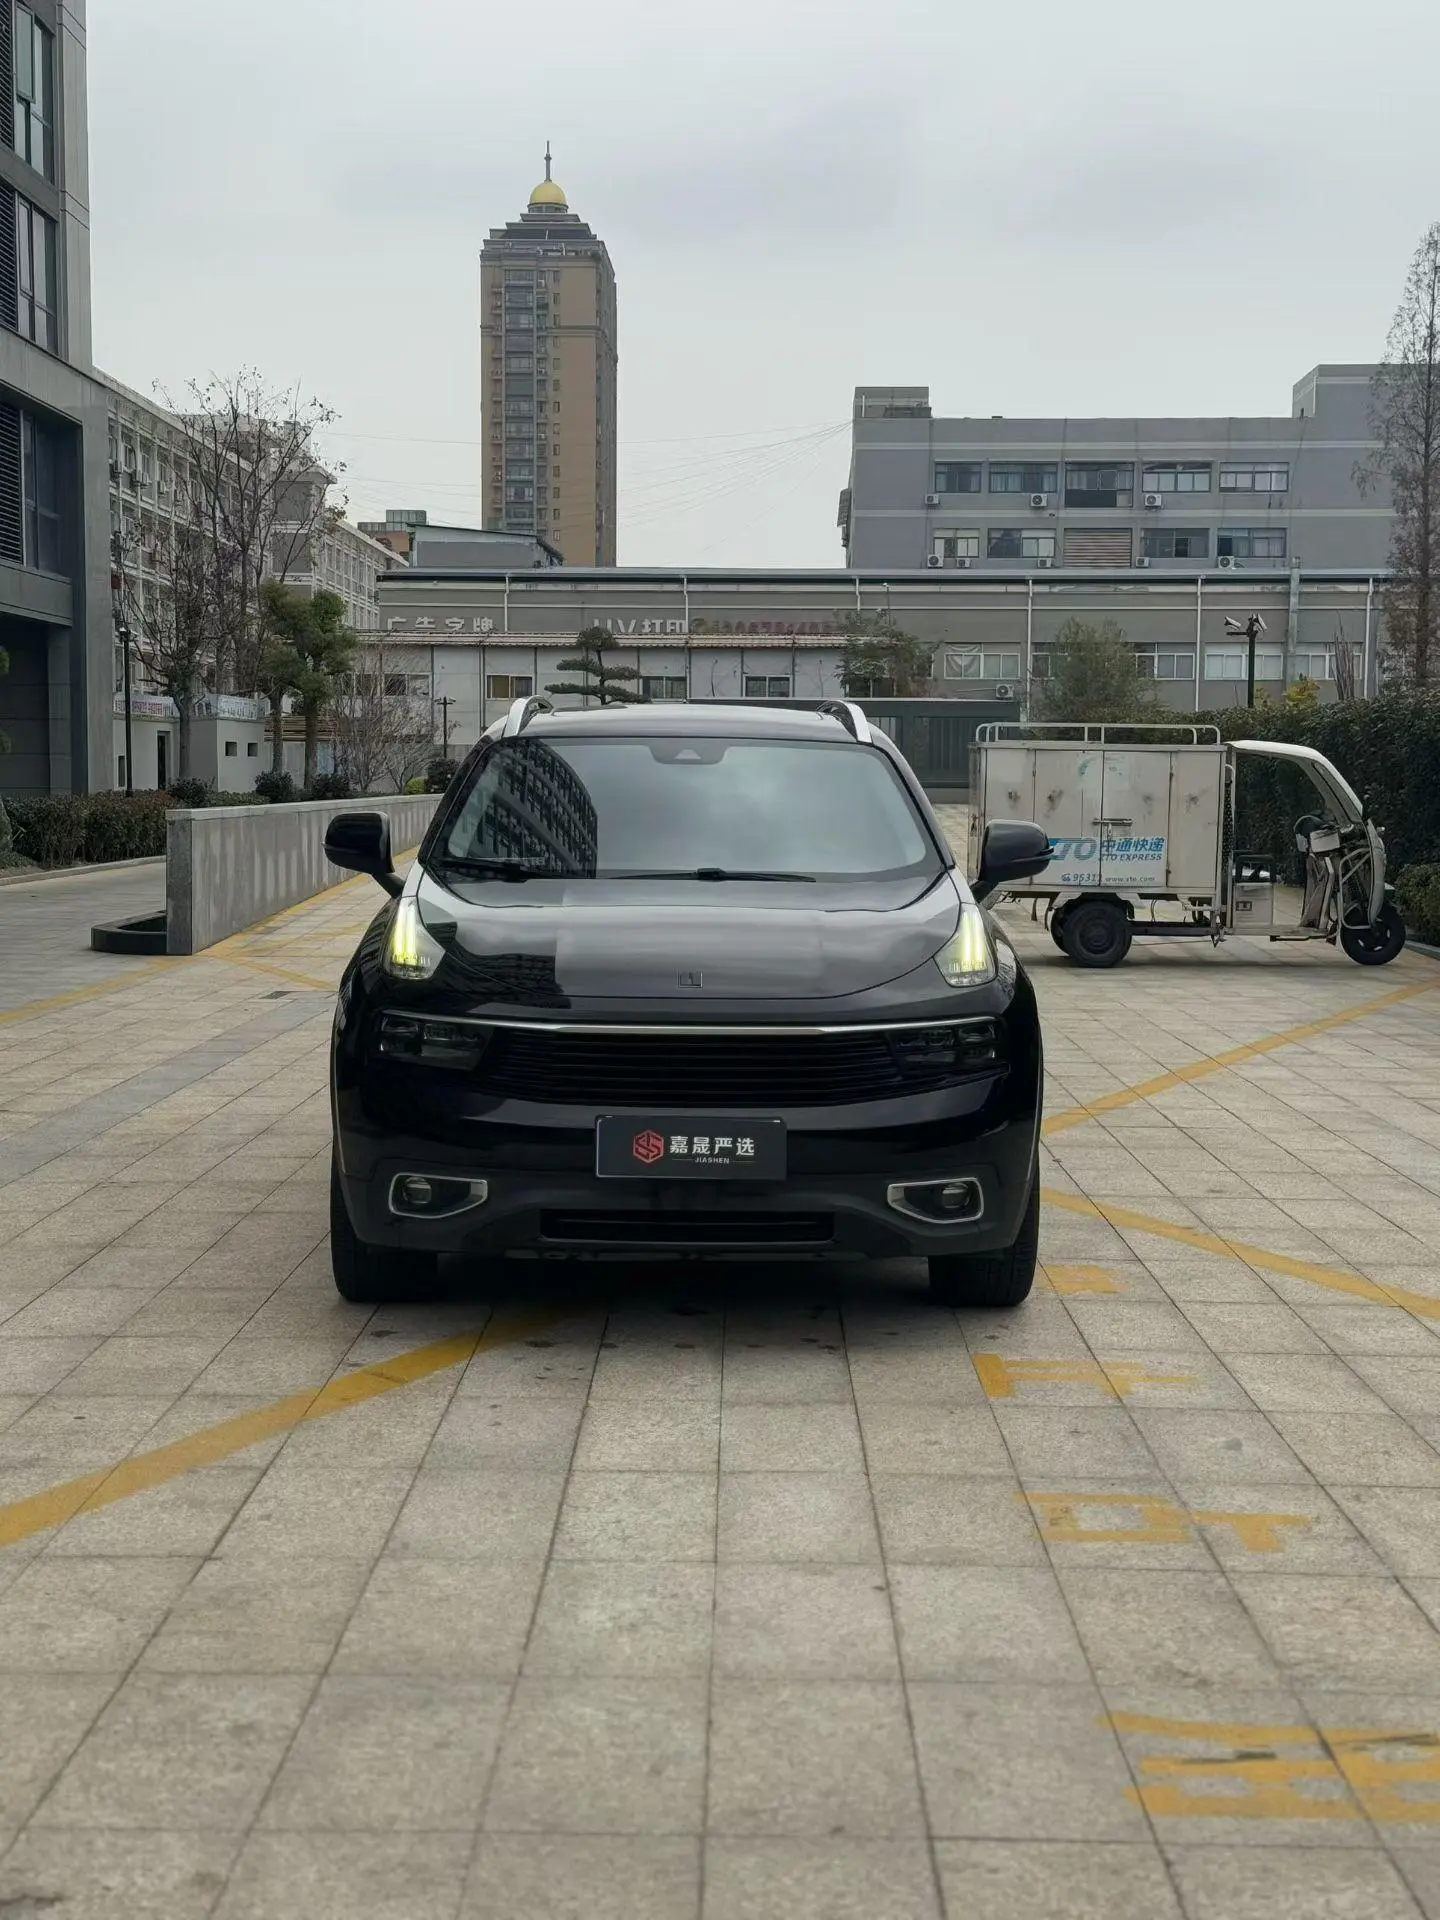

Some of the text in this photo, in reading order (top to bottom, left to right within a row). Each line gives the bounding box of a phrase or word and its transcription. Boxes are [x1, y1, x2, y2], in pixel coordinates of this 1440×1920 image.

[1101, 837, 1165, 853] 中通快递
[1120, 853, 1162, 861] EXPRESS
[669, 1135, 755, 1156] 嘉晟严选
